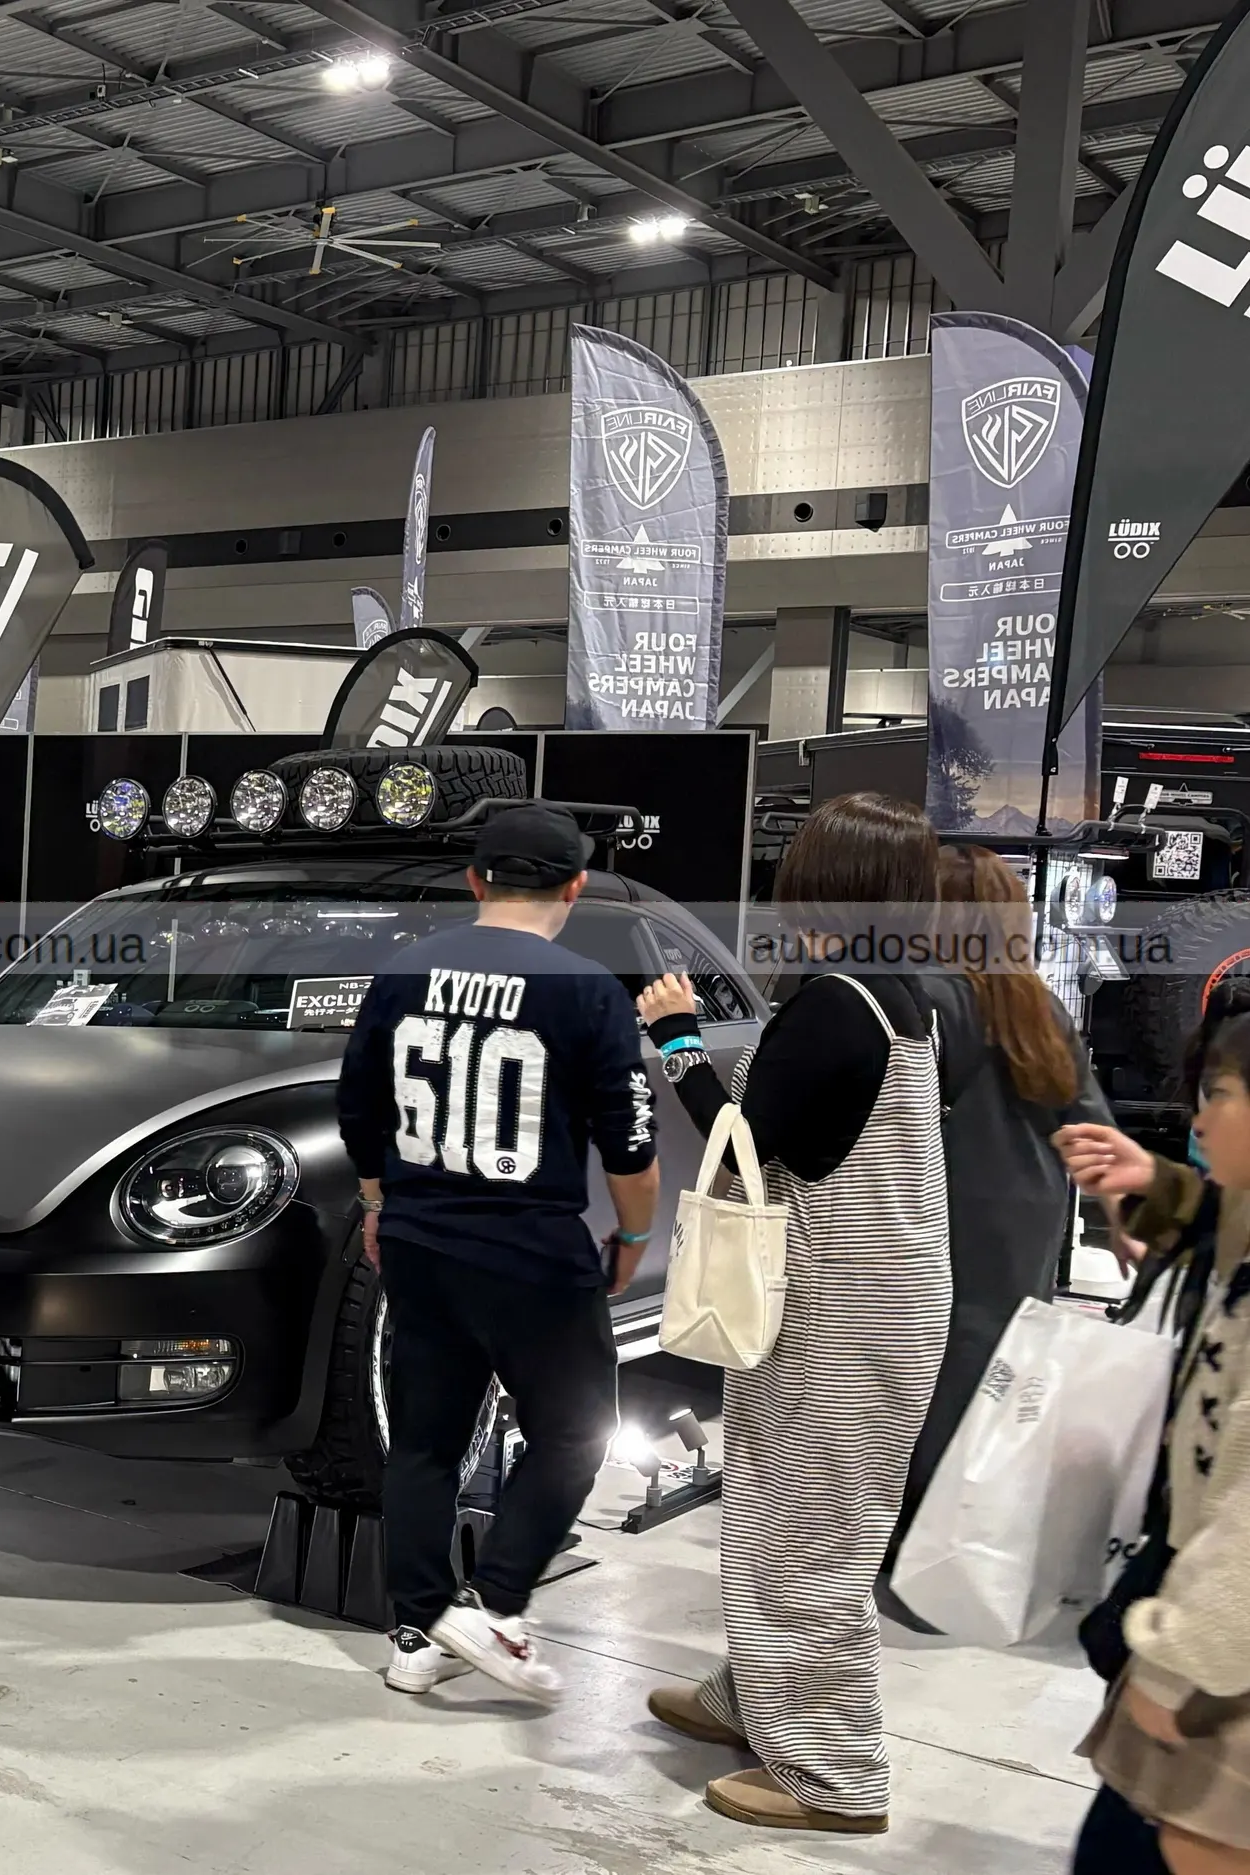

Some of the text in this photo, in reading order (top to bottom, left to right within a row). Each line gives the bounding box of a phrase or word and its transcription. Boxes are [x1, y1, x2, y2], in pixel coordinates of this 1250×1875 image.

[1108, 518, 1161, 537] LÜDIX
[296, 994, 365, 1009] EXCLU
[424, 968, 526, 1021] KYOTO
[392, 1013, 550, 1183] 610
